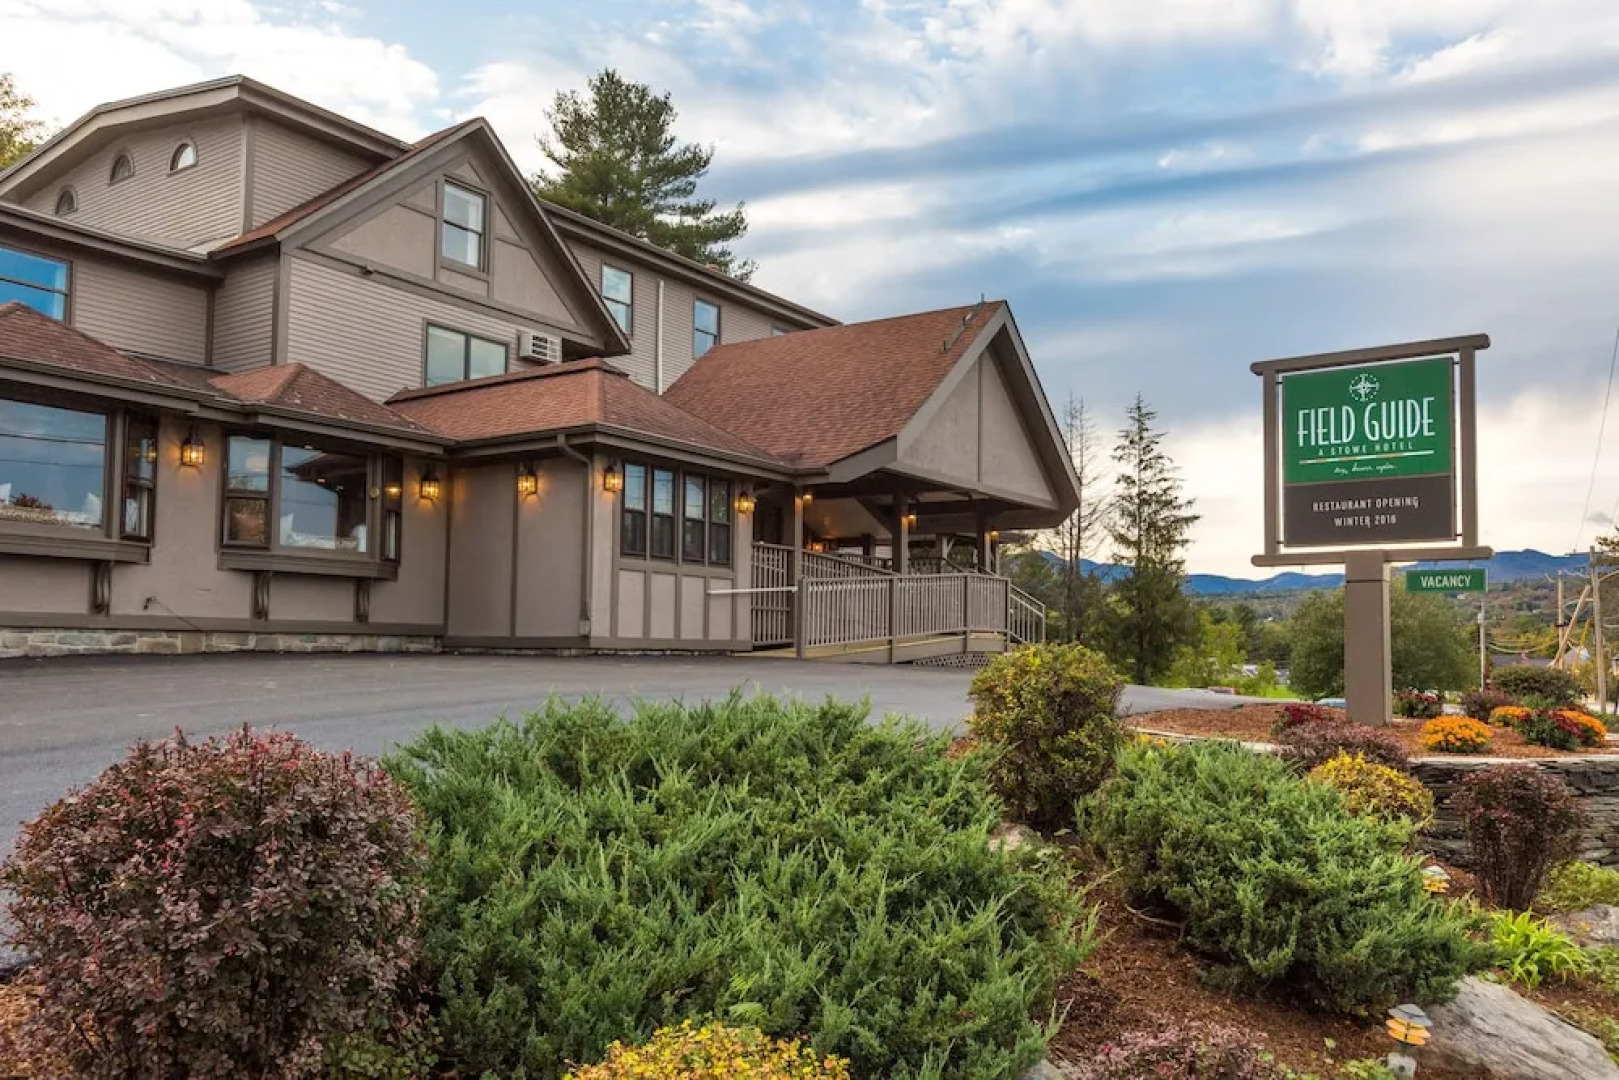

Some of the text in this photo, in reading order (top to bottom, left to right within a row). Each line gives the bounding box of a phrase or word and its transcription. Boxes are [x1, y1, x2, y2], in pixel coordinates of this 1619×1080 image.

[1297, 397, 1436, 447] FIELD GUIDE
[1318, 441, 1413, 456] A STOWE HOTEL
[1312, 496, 1420, 512] RESTAURANT OPENING
[1333, 514, 1397, 528] WINTER 2016
[1420, 574, 1472, 589] VACANCY
